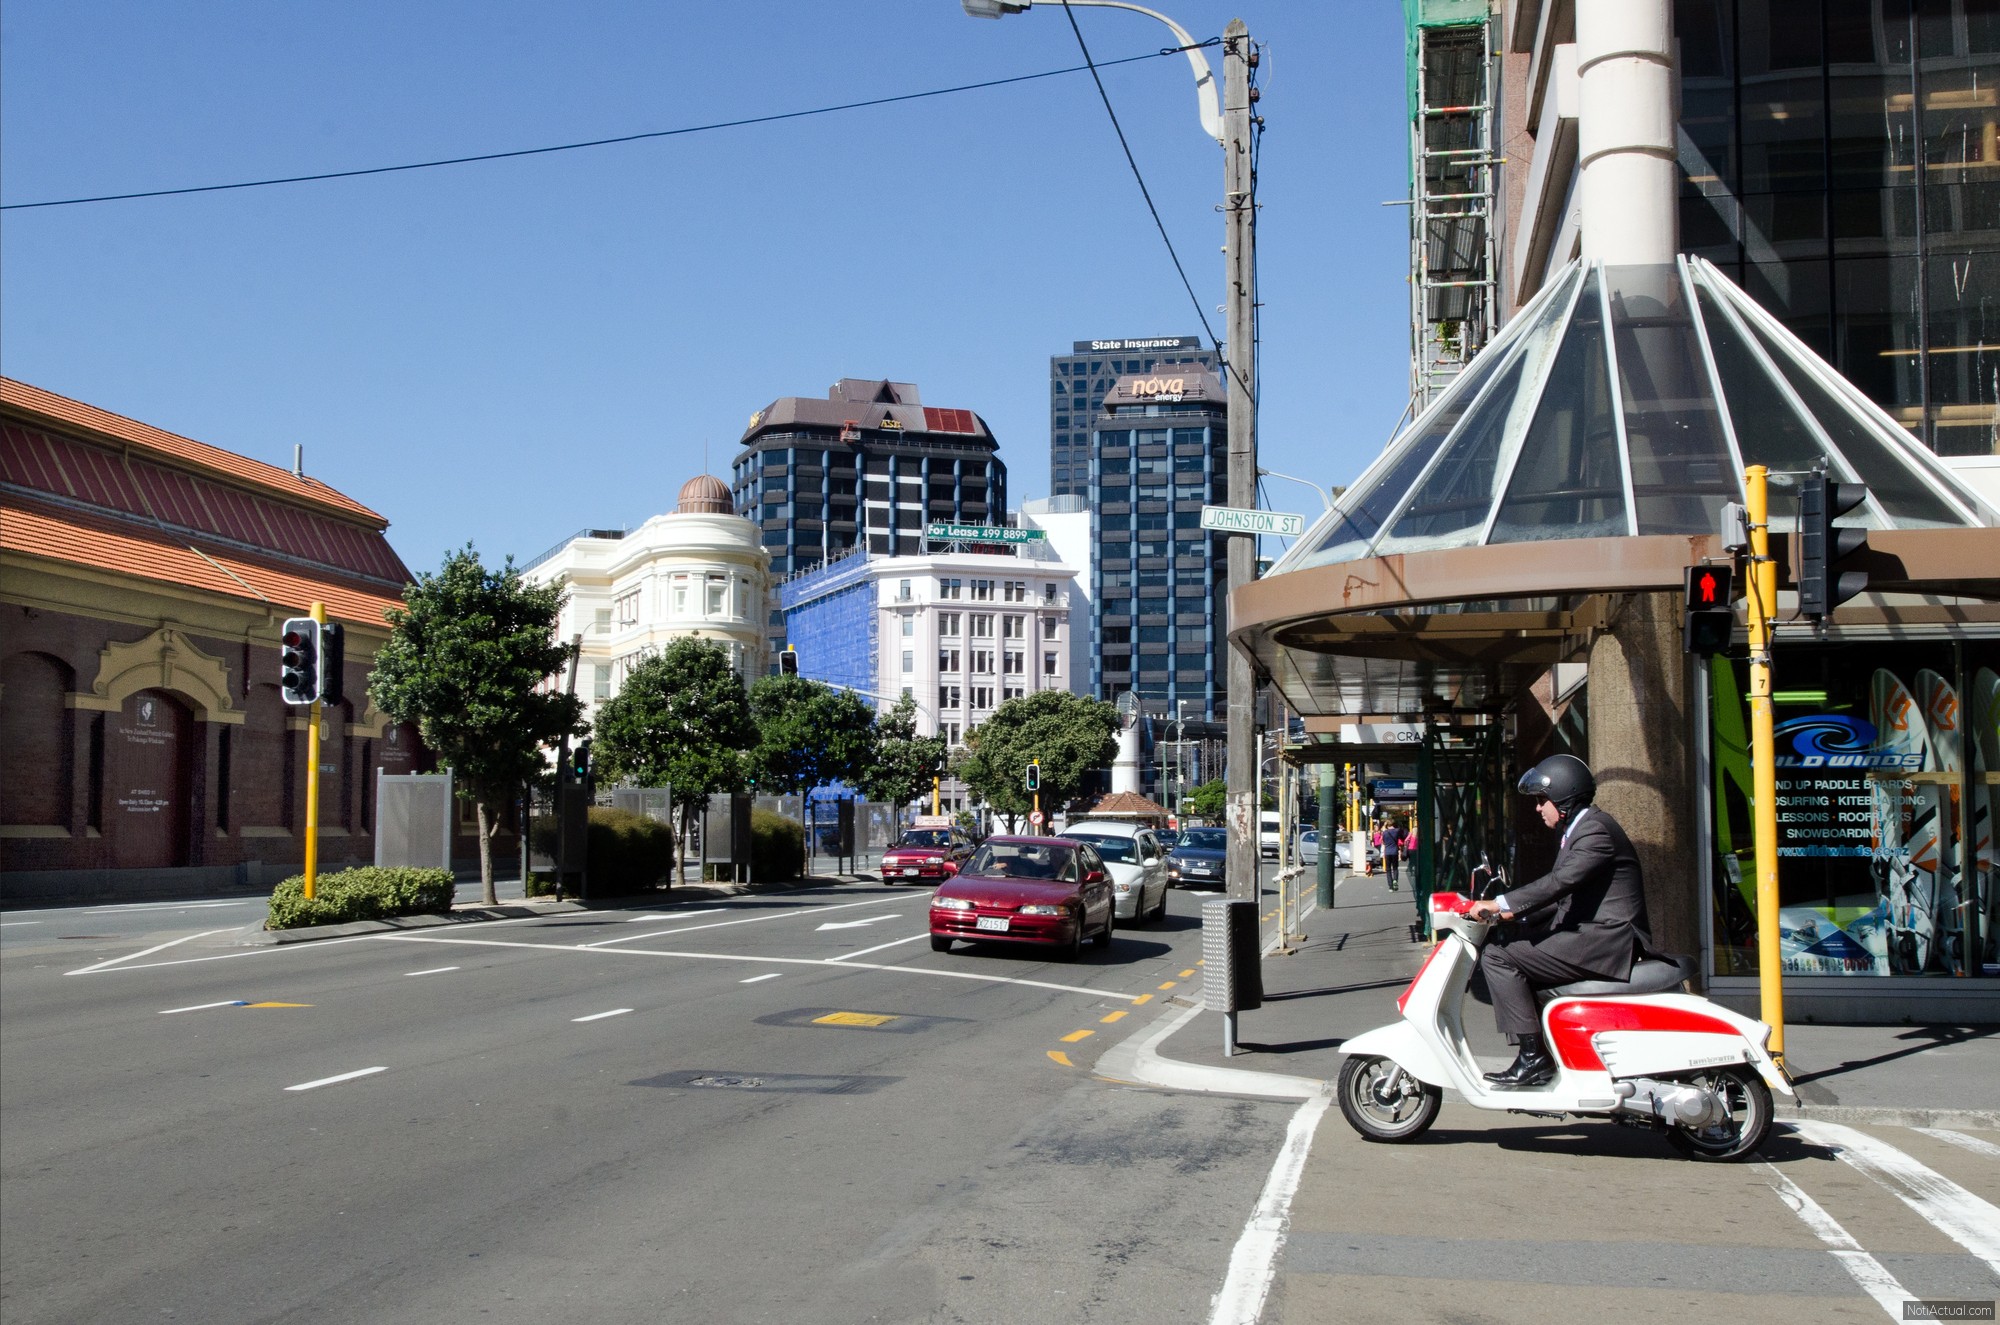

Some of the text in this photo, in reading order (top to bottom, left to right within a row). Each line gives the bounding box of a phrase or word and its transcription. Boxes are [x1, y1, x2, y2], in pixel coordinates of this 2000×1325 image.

[1091, 339, 1180, 350] State Insurance
[1131, 377, 1184, 395] nova
[1155, 393, 1182, 402] energy
[1209, 510, 1297, 533] JOHNSTON ST
[927, 525, 1028, 540] For Lease 499 8899
[1759, 678, 1766, 689] 7
[1397, 731, 1423, 742] CRA
[1828, 754, 1923, 767] WINDS
[1795, 780, 1811, 790] UP
[1814, 780, 1860, 790] PADDLE
[1863, 780, 1913, 790] BOARDS
[1838, 796, 1926, 806] KITEBOARDING
[1775, 812, 1829, 822] LESSONS
[1786, 828, 1883, 839] SNOWBOARDING
[1776, 844, 1909, 857] ww.wildwinds.co.nz
